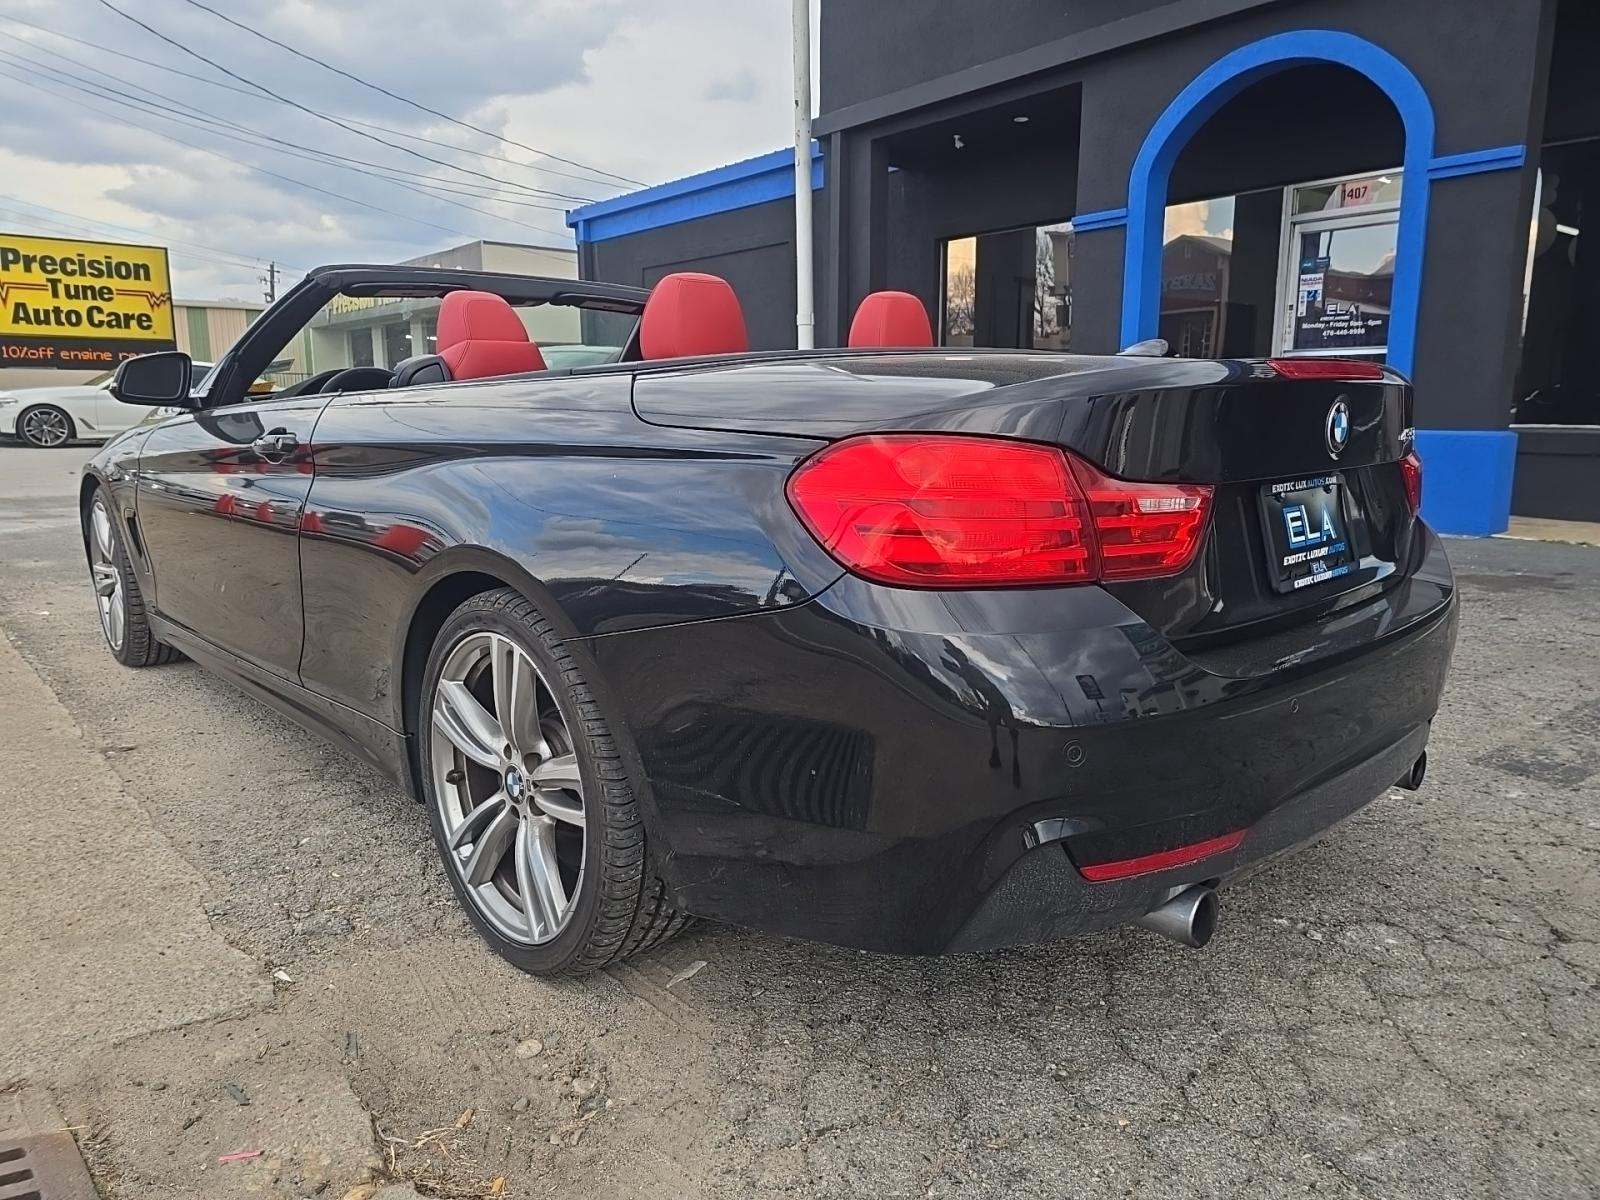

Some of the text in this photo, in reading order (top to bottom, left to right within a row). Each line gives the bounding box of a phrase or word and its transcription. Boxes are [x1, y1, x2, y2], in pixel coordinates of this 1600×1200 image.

[0, 247, 151, 281] Precision
[46, 278, 114, 302] Tune
[12, 302, 153, 330] Auto Care
[1326, 302, 1357, 315] ELA
[1302, 322, 1325, 330] Monday
[1330, 320, 1349, 329] Friday
[60, 348, 113, 362] engine
[1272, 482, 1295, 494] EXOTIC
[1295, 480, 1307, 490] LUX
[1283, 503, 1337, 549] ELA
[1283, 543, 1345, 566] EXOTIC LUXURY AUTOS
